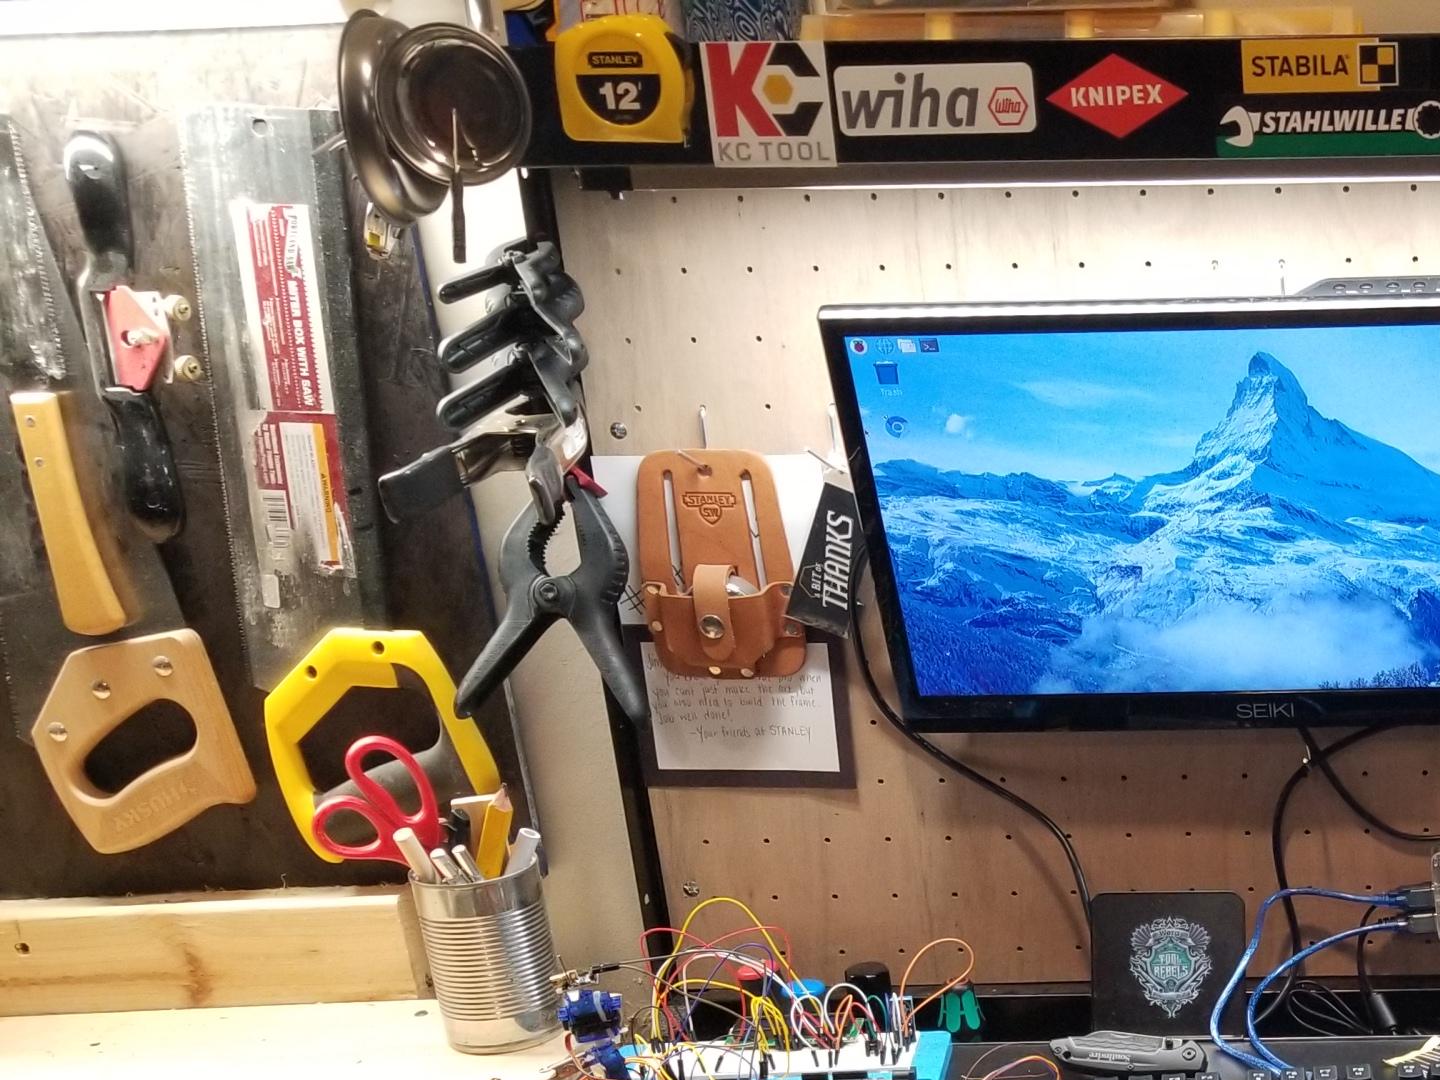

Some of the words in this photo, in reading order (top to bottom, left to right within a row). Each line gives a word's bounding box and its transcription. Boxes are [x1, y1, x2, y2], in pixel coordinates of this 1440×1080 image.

[591, 54, 640, 65] STANLEY
[1251, 54, 1349, 77] STABILA
[841, 73, 979, 130] wiha
[1070, 82, 1164, 108] KNIPEX
[1262, 107, 1408, 134] STAHLWILLE
[718, 142, 753, 161] KC
[757, 140, 831, 161] TOOL
[292, 320, 306, 346] BOX
[297, 347, 310, 377] WITH
[301, 380, 314, 407] SAW
[880, 388, 903, 397] Trash
[687, 494, 732, 505] STANLEY
[822, 510, 854, 611] THANKS
[811, 571, 822, 592] BIT
[1236, 703, 1295, 719] SEIKI
[769, 726, 812, 743] STANLEY
[1158, 953, 1181, 965] TOOL
[1153, 965, 1189, 980] REBELS
[1088, 1051, 1131, 1062] Southwire
